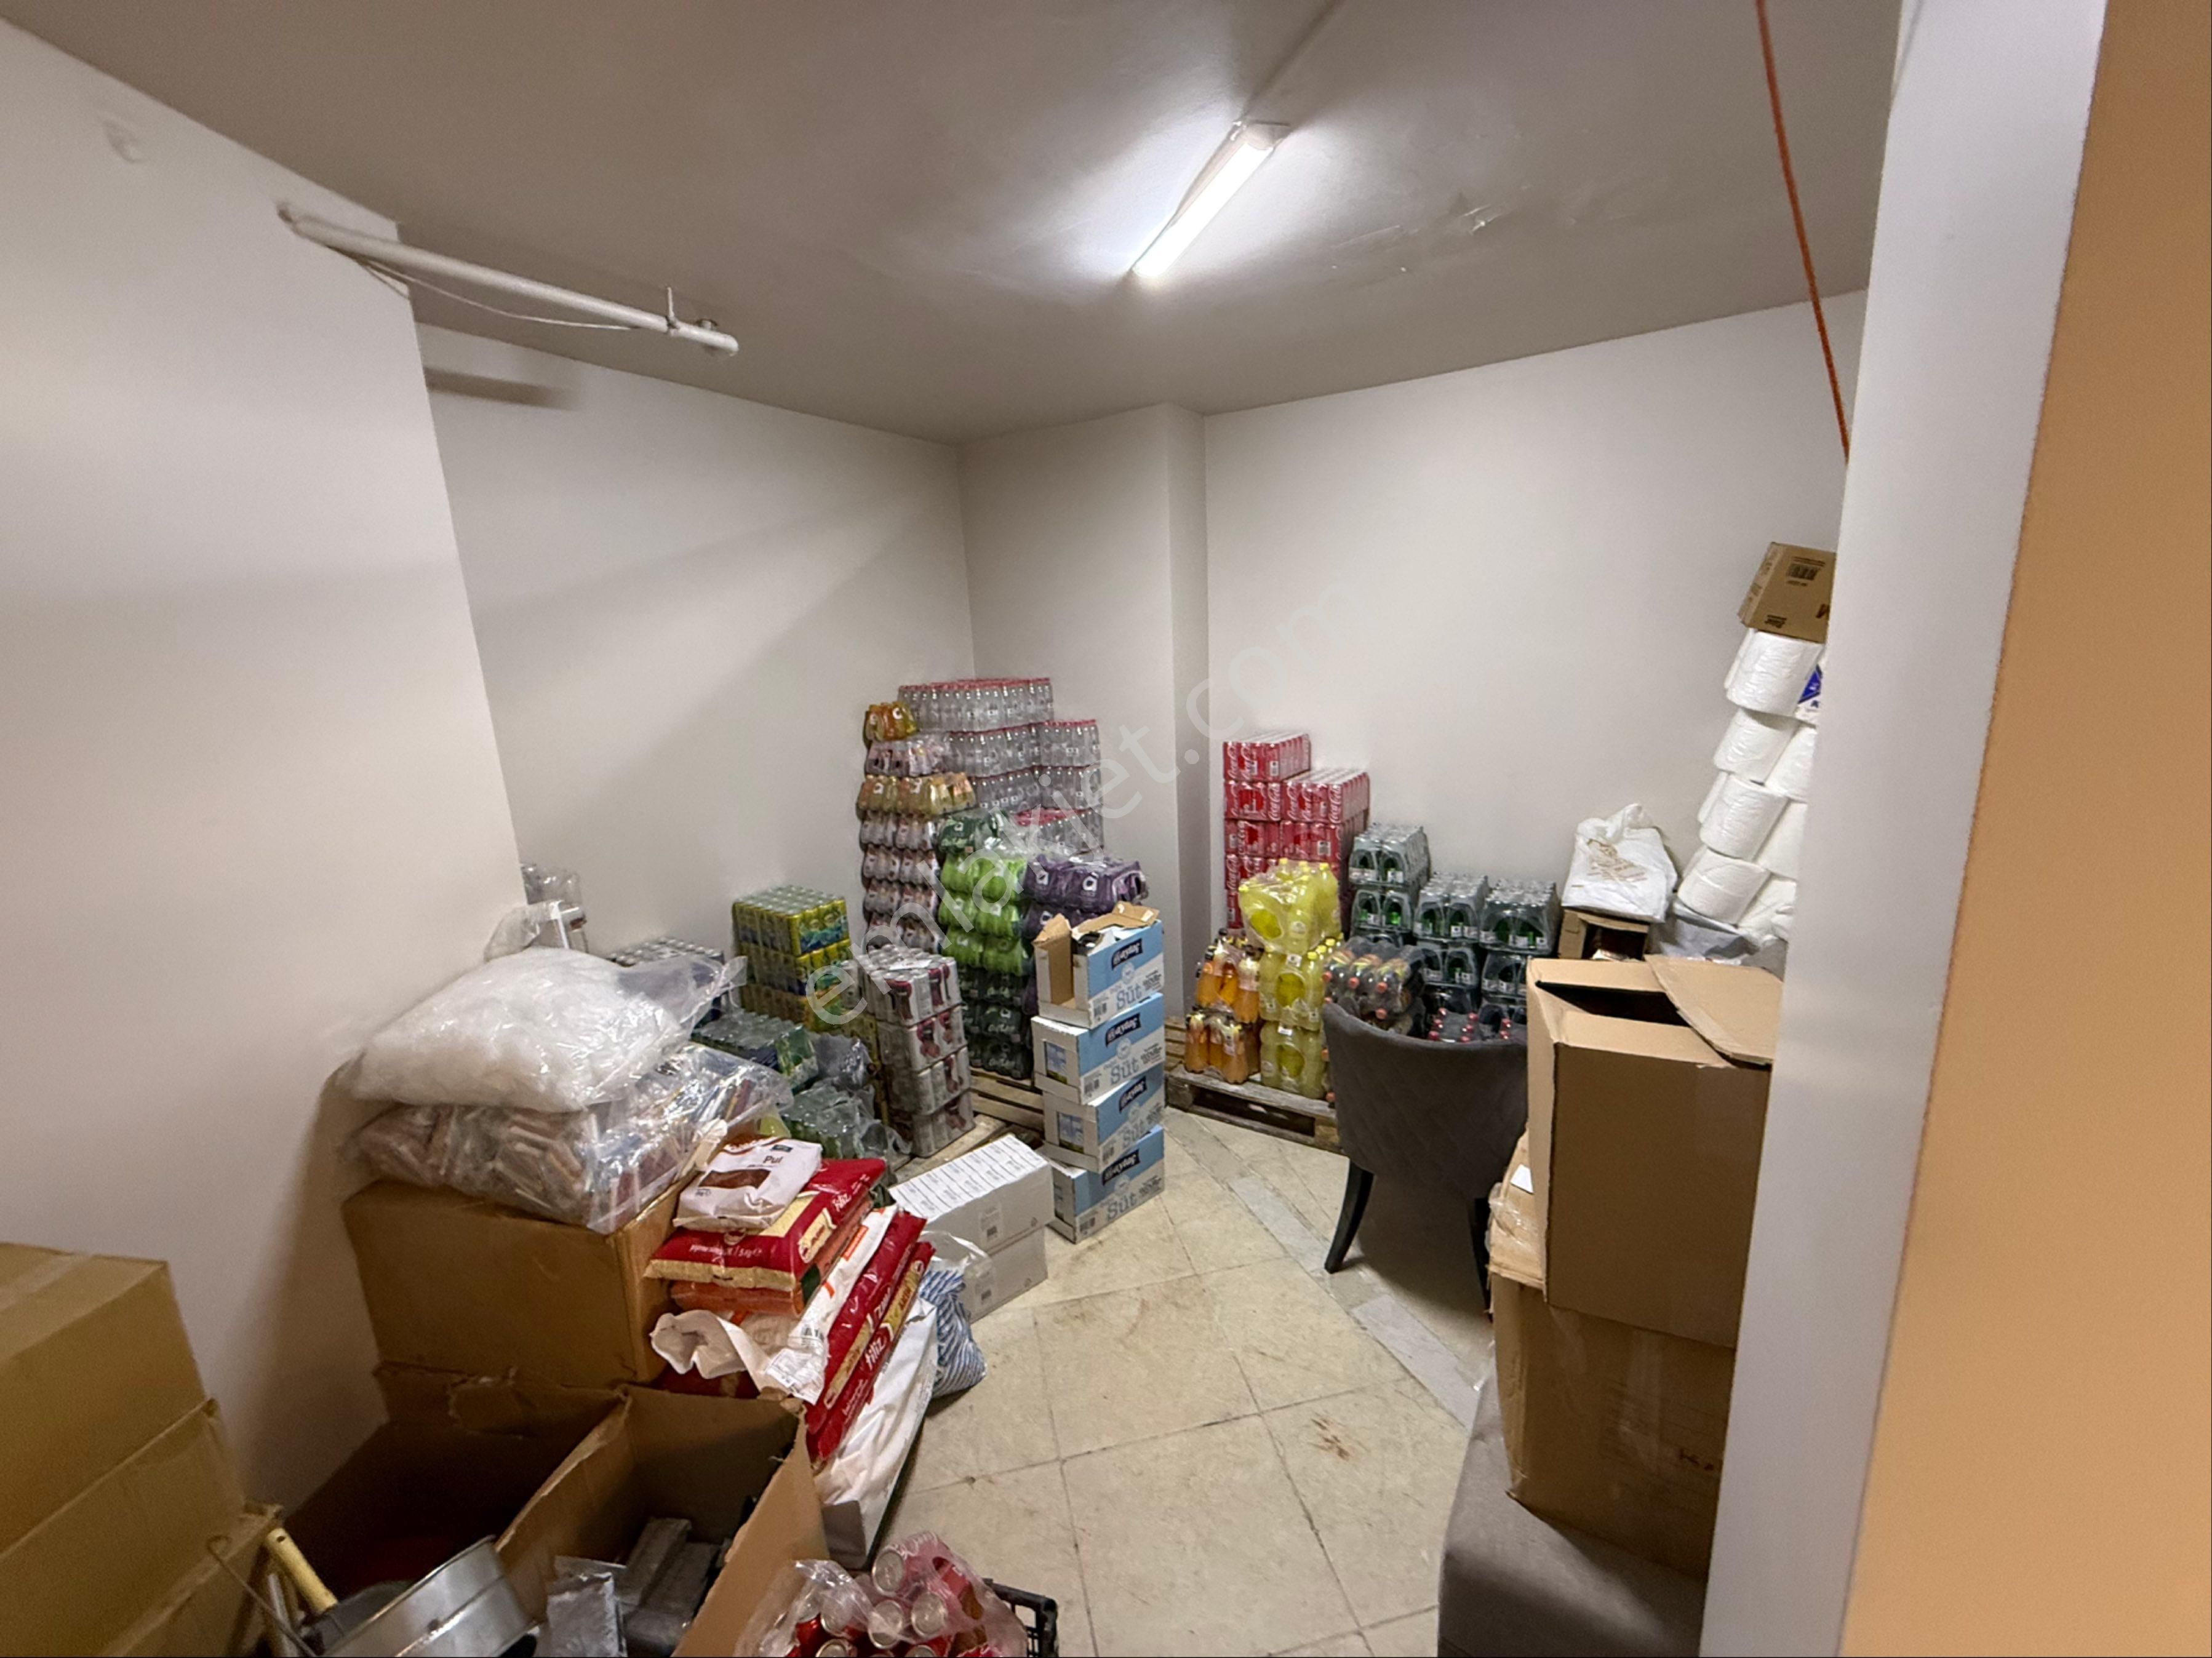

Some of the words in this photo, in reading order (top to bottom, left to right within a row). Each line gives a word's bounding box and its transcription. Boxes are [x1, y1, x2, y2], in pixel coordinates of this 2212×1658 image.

[1116, 984, 1142, 1010] Süt
[1111, 1058, 1139, 1085] Süt
[763, 1155, 783, 1163] Pul
[1108, 1192, 1137, 1220] Süt
